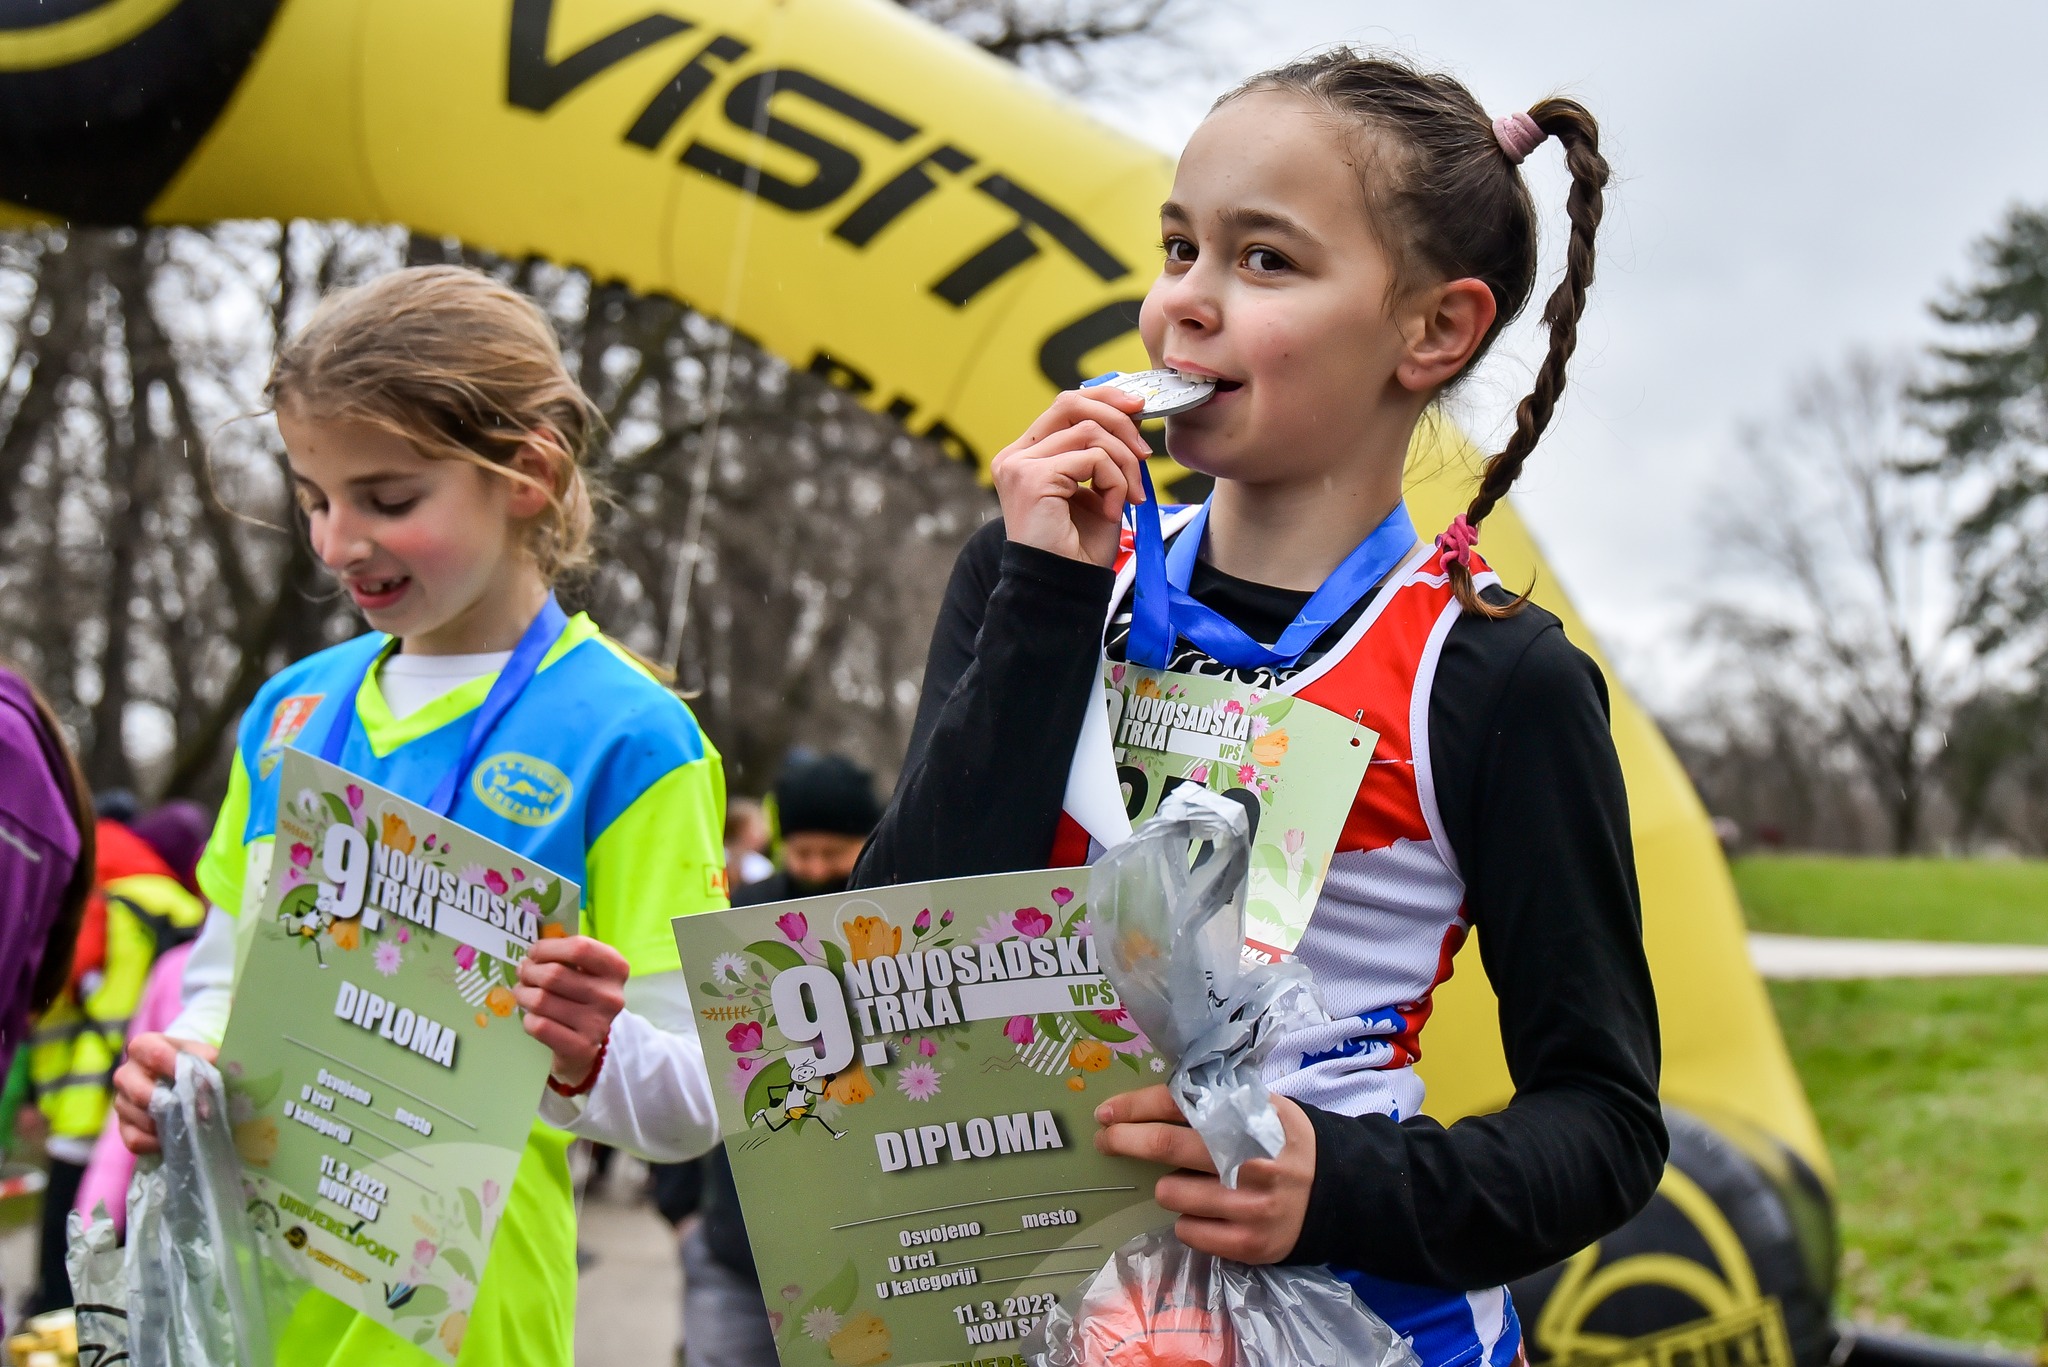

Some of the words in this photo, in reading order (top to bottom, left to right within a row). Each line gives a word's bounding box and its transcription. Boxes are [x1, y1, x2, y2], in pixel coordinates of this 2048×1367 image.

[1119, 718, 1168, 751] TRKA
[1125, 694, 1250, 741] NOVOSADSKA
[1218, 743, 1242, 761] VPŠ
[318, 823, 381, 931] 9.
[371, 840, 539, 943] NOVOSADSKA
[369, 871, 434, 930] TRKA
[506, 939, 527, 962] VP
[1240, 944, 1273, 965] RKA
[1067, 977, 1115, 1007] VPŠ
[334, 980, 457, 1068] DIPLOMA
[770, 965, 889, 1077] 9.
[854, 986, 961, 1037] TRKA
[874, 1110, 1064, 1173] DIPLOMA
[318, 1176, 350, 1208] NOVI
[350, 1192, 379, 1222] SAD
[899, 1221, 981, 1247] Osvojeno
[1021, 1209, 1078, 1229] mesto
[888, 1256, 901, 1273] U
[903, 1250, 936, 1270] trci
[876, 1282, 889, 1299] U
[891, 1267, 978, 1297] kategoriji
[953, 1304, 980, 1324] 11.
[981, 1301, 1002, 1321] 3.
[966, 1320, 1015, 1345] NOVI
